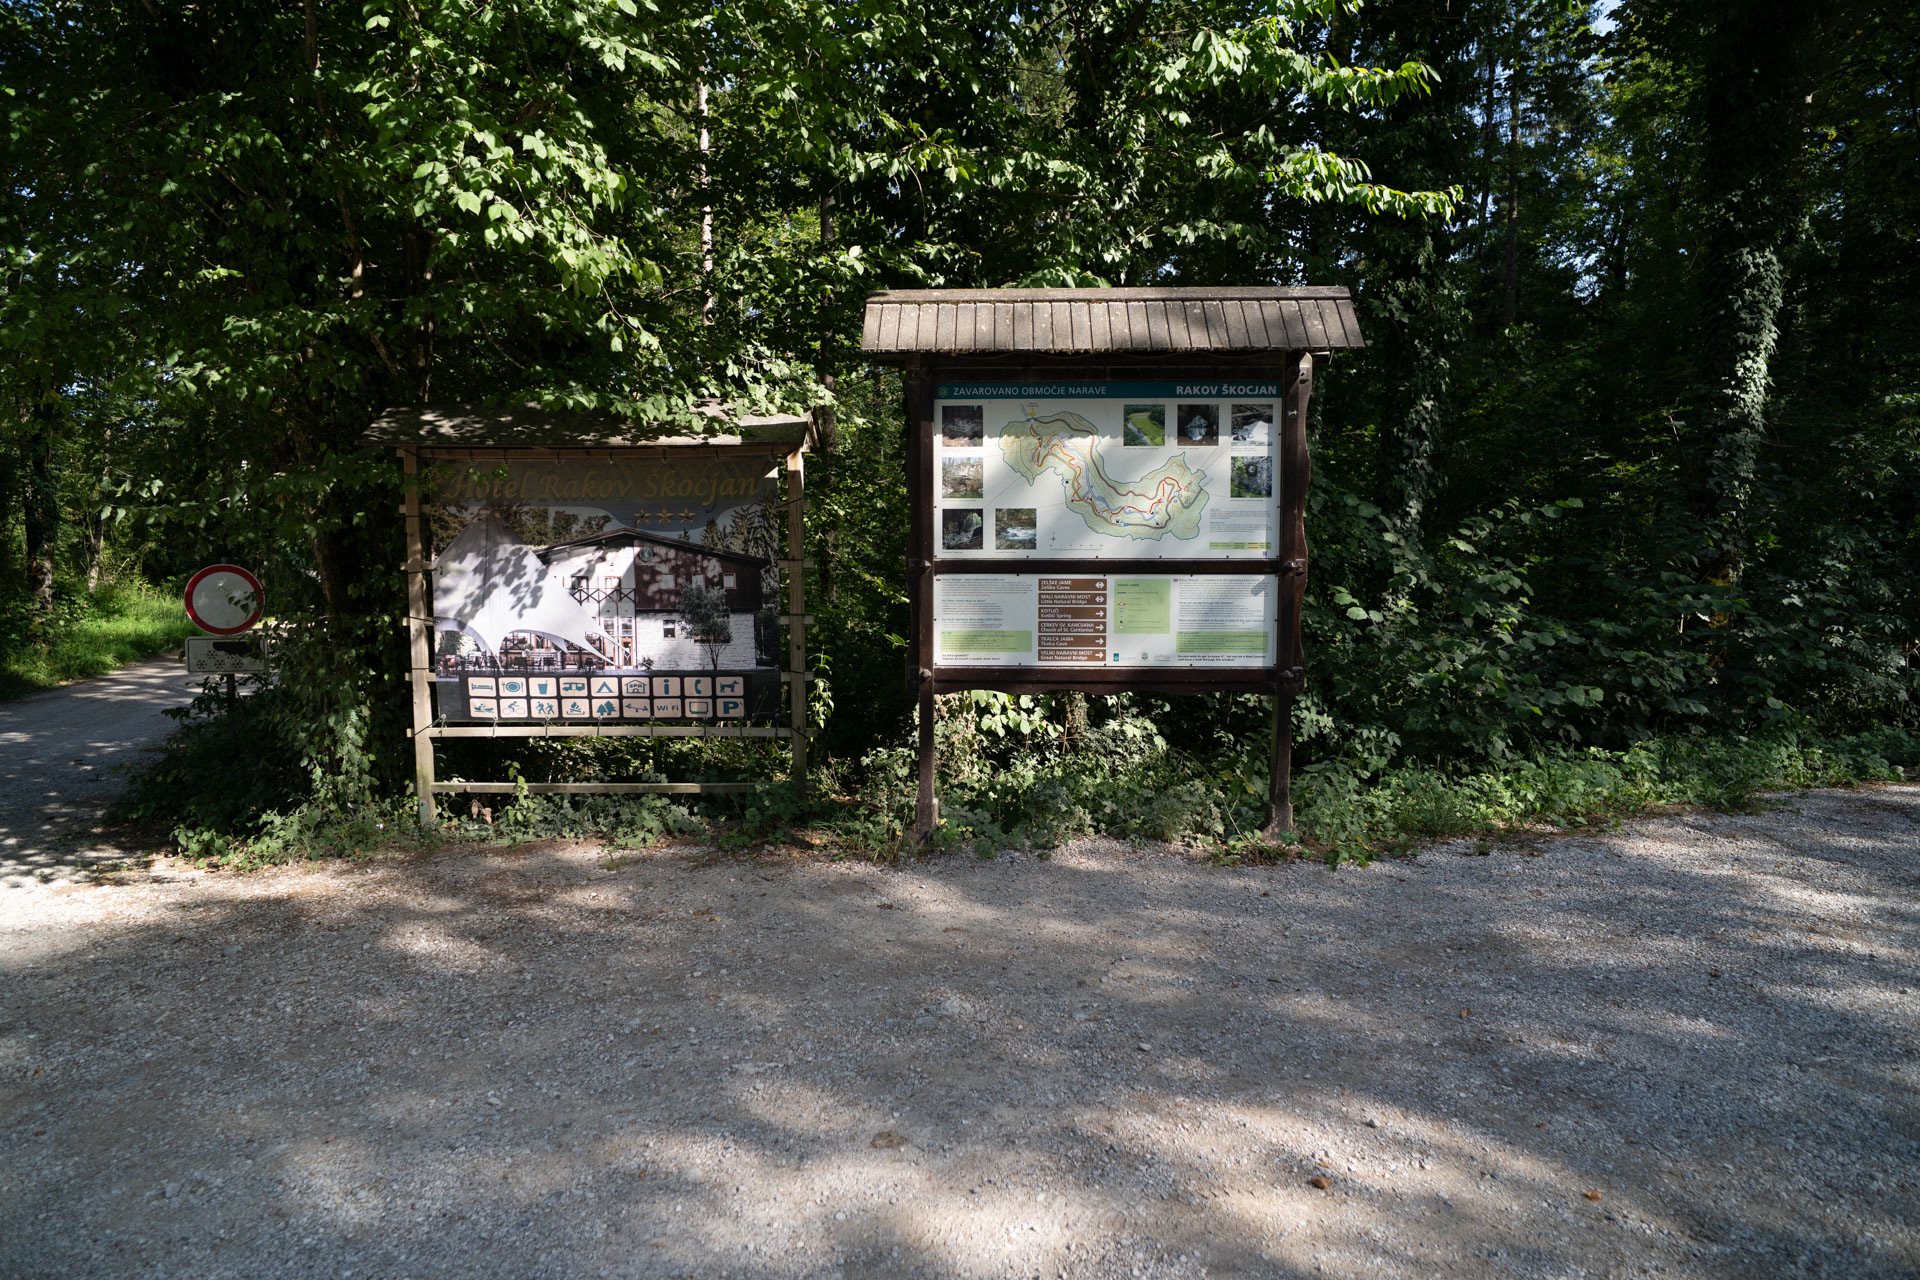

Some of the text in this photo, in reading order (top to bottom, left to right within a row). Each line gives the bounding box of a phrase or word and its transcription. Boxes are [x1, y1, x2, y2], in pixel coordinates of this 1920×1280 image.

[953, 385, 1107, 396] ZAVAROVANO OBMOČJE NARAVE
[1176, 383, 1277, 395] RAKOV ŠKOCJAN
[442, 466, 758, 506] Hotel Rakov Škocjan
[723, 701, 737, 714] P
